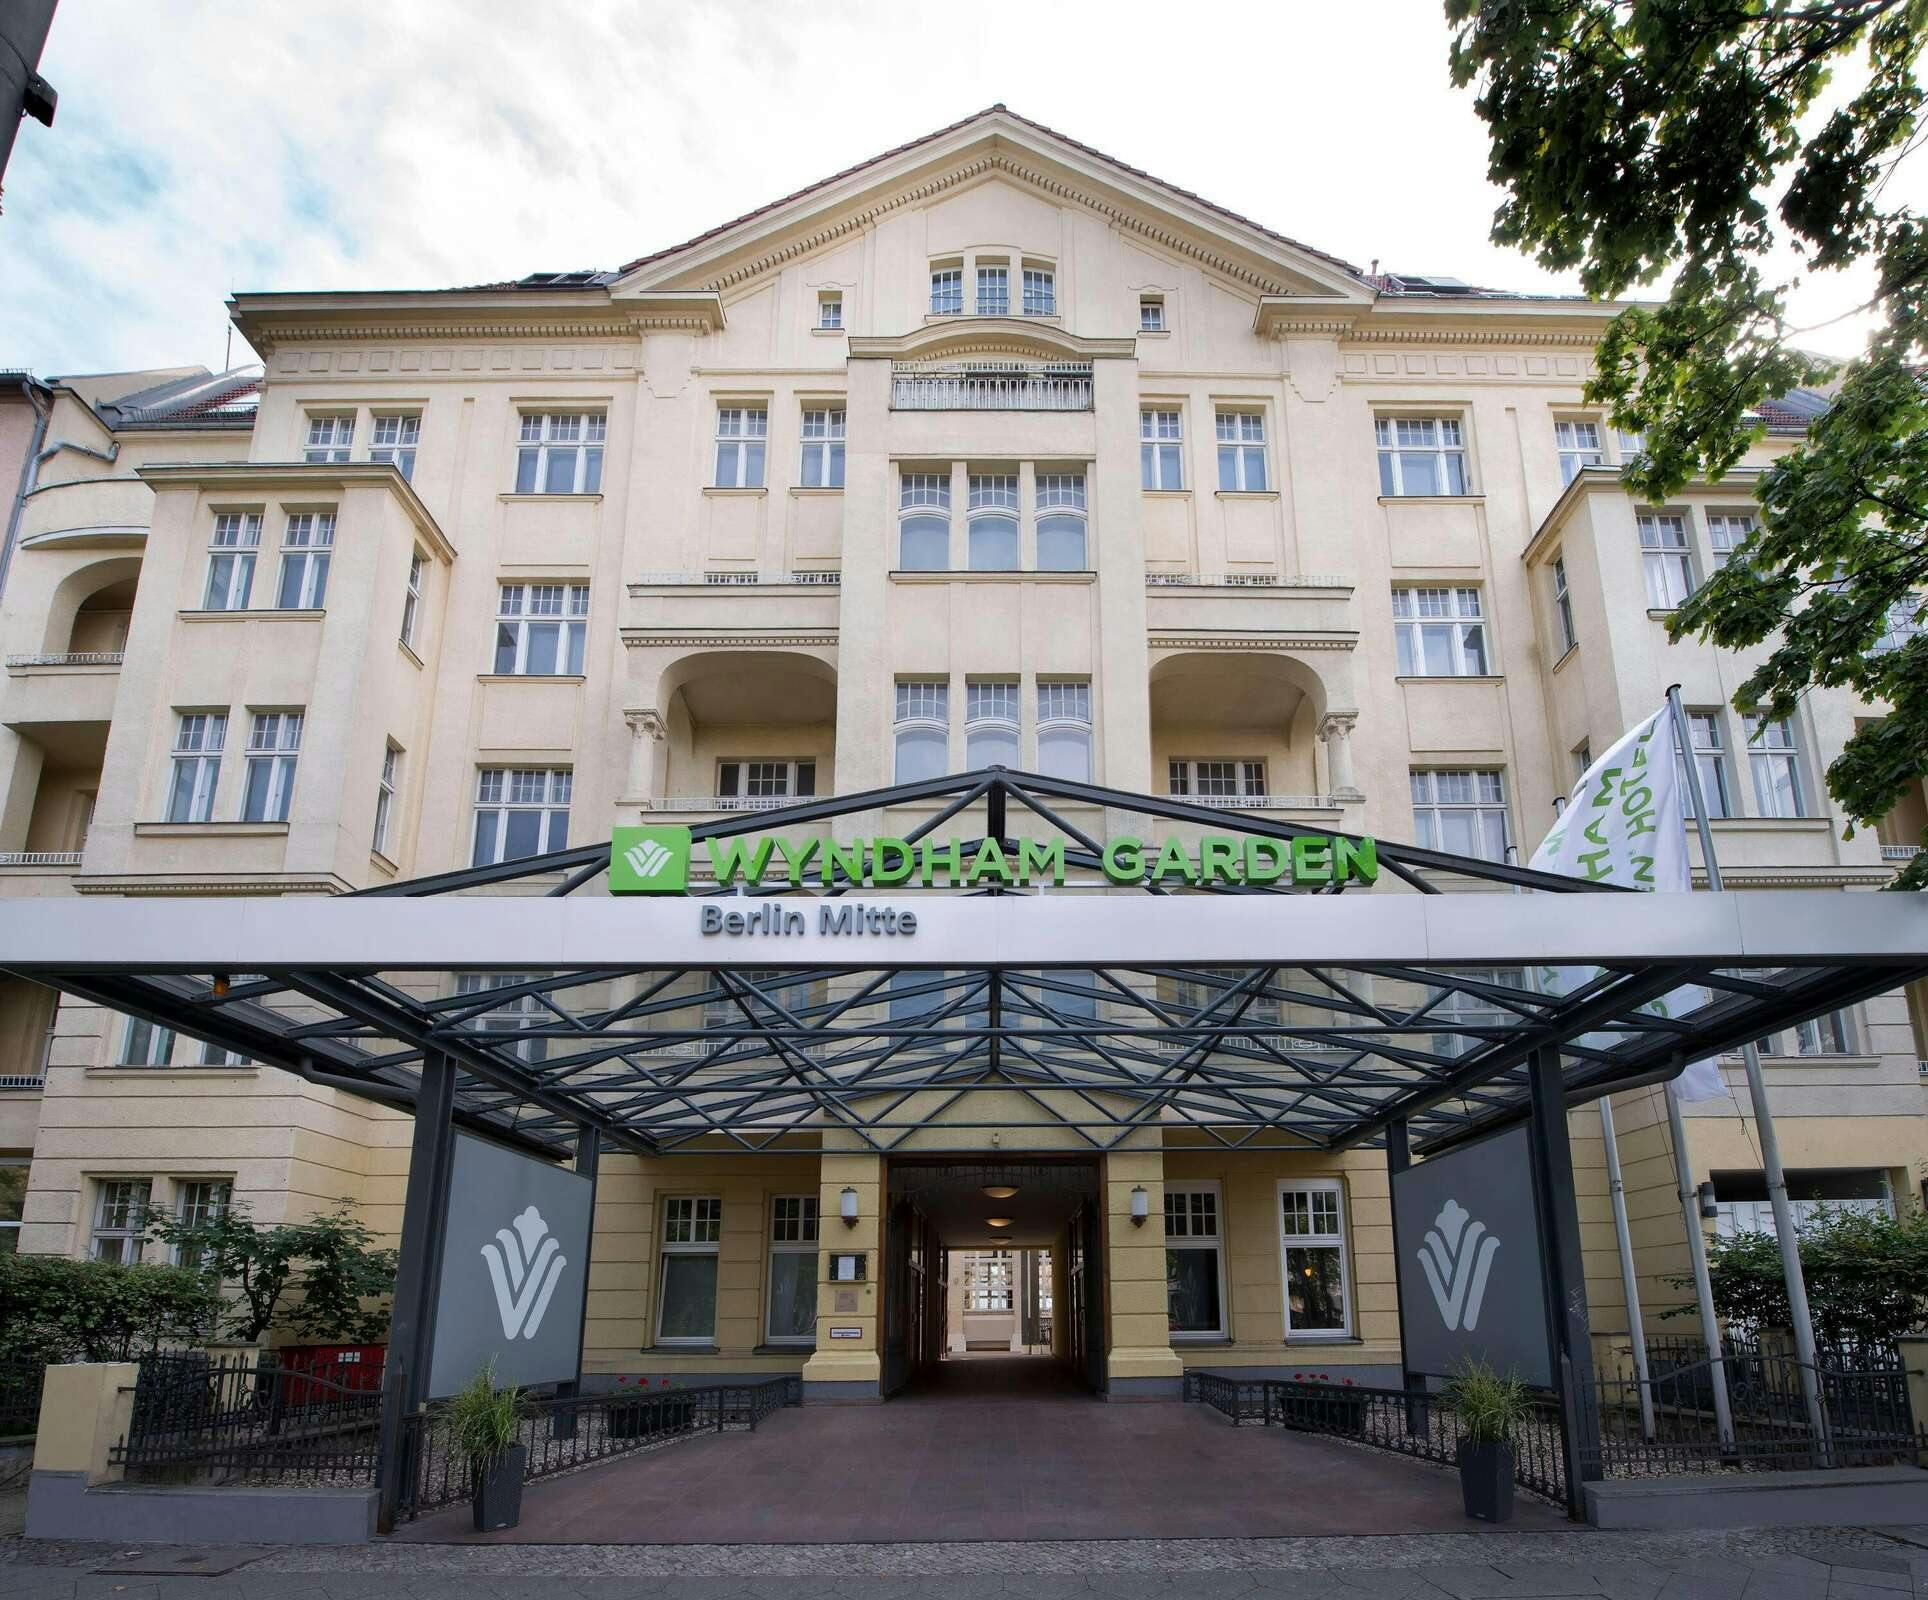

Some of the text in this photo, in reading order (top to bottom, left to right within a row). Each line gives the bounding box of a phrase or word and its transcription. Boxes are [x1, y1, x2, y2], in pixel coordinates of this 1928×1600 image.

[1620, 719, 1656, 840] HOTEL
[704, 835, 1379, 888] WYNDHAM GARDEN
[701, 903, 918, 935] Berlin Mitte
